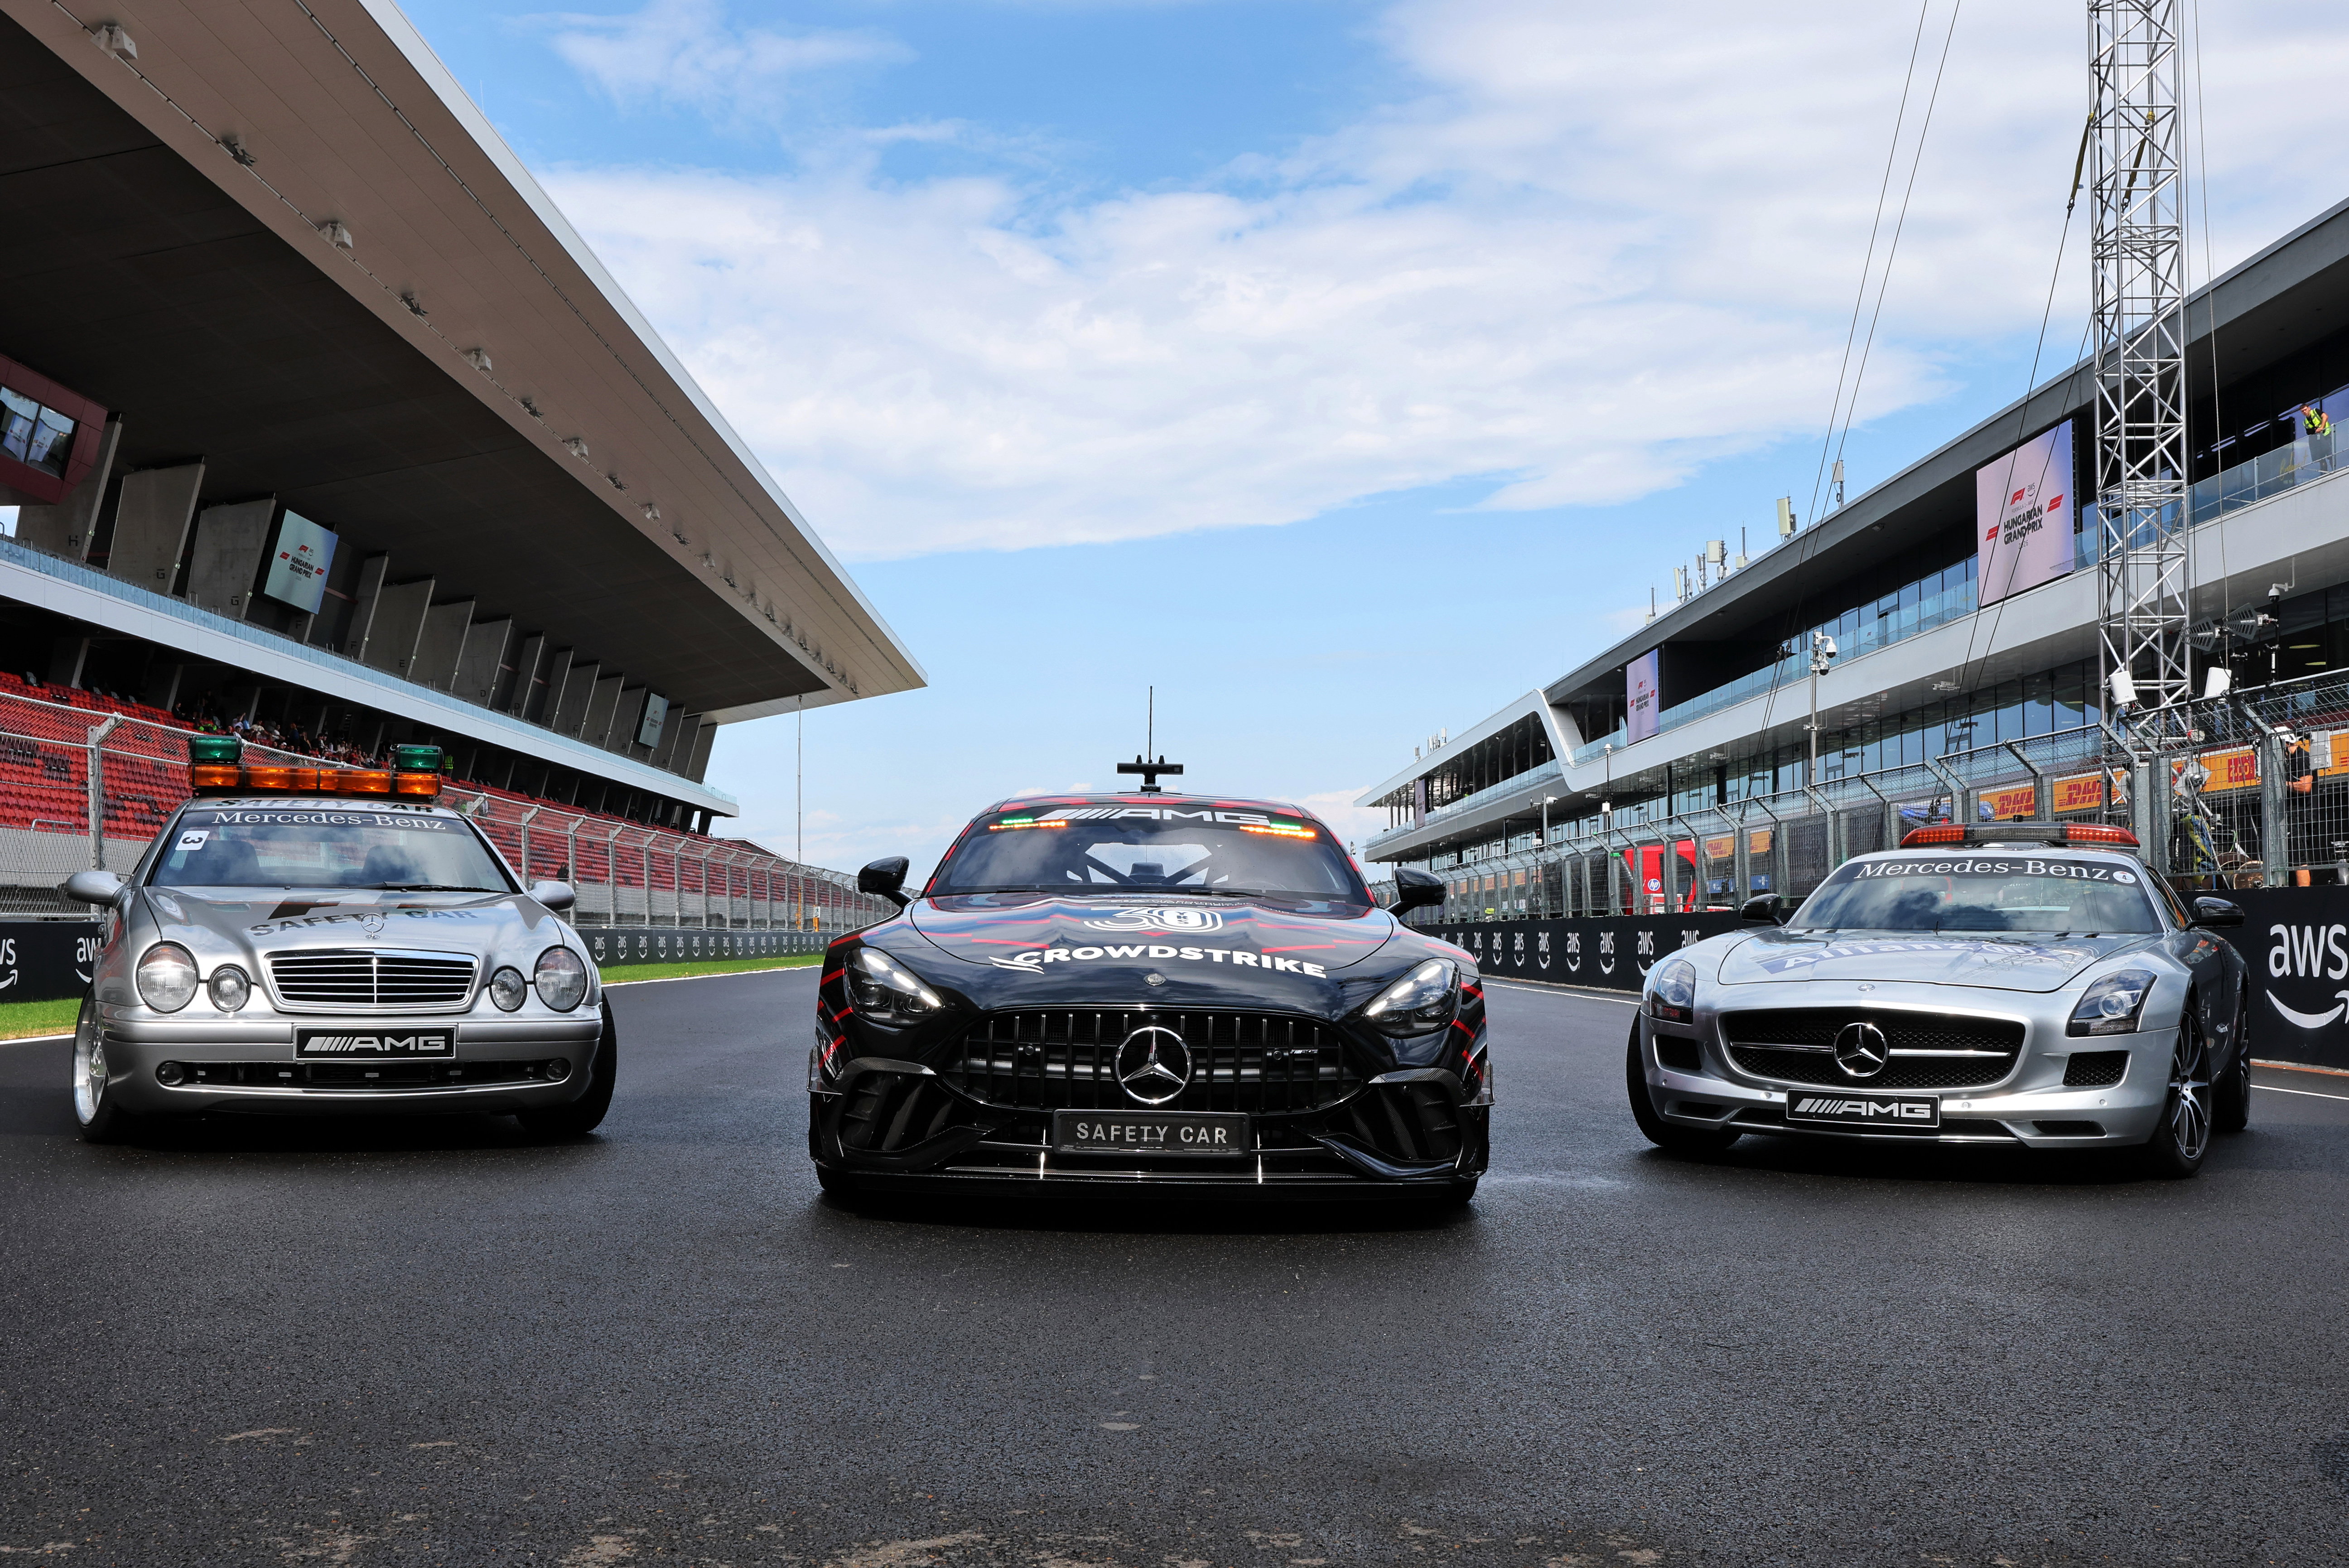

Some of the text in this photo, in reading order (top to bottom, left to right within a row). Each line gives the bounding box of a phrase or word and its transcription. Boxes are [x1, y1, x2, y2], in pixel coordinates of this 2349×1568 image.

[2004, 504, 2043, 533] HUNGARIAN
[2004, 517, 2043, 545] GRAND PRIX
[289, 563, 303, 575] GRAND
[302, 569, 312, 579] PRIX
[291, 555, 314, 572] HUNGARIAN
[215, 799, 434, 813] SAFETY CAR
[212, 811, 446, 830] Mercedes-Benz
[1109, 809, 1270, 826] AMG
[1854, 859, 2109, 880] Mercedes-Benz
[1650, 880, 1659, 891] hp
[405, 911, 478, 919] CAR
[595, 936, 605, 950] aws
[1539, 931, 1549, 952] aws
[1567, 931, 1580, 953] aws
[1600, 931, 1614, 954] aws
[1638, 931, 1654, 955] aws
[2269, 924, 2349, 980] aws
[1013, 945, 1327, 979] CROWDSTRIKE
[1784, 941, 1973, 969] Allianz
[348, 1036, 445, 1051] AMG
[1835, 1100, 1931, 1119] AMG
[1076, 1122, 1227, 1144] SAFETY CAR
